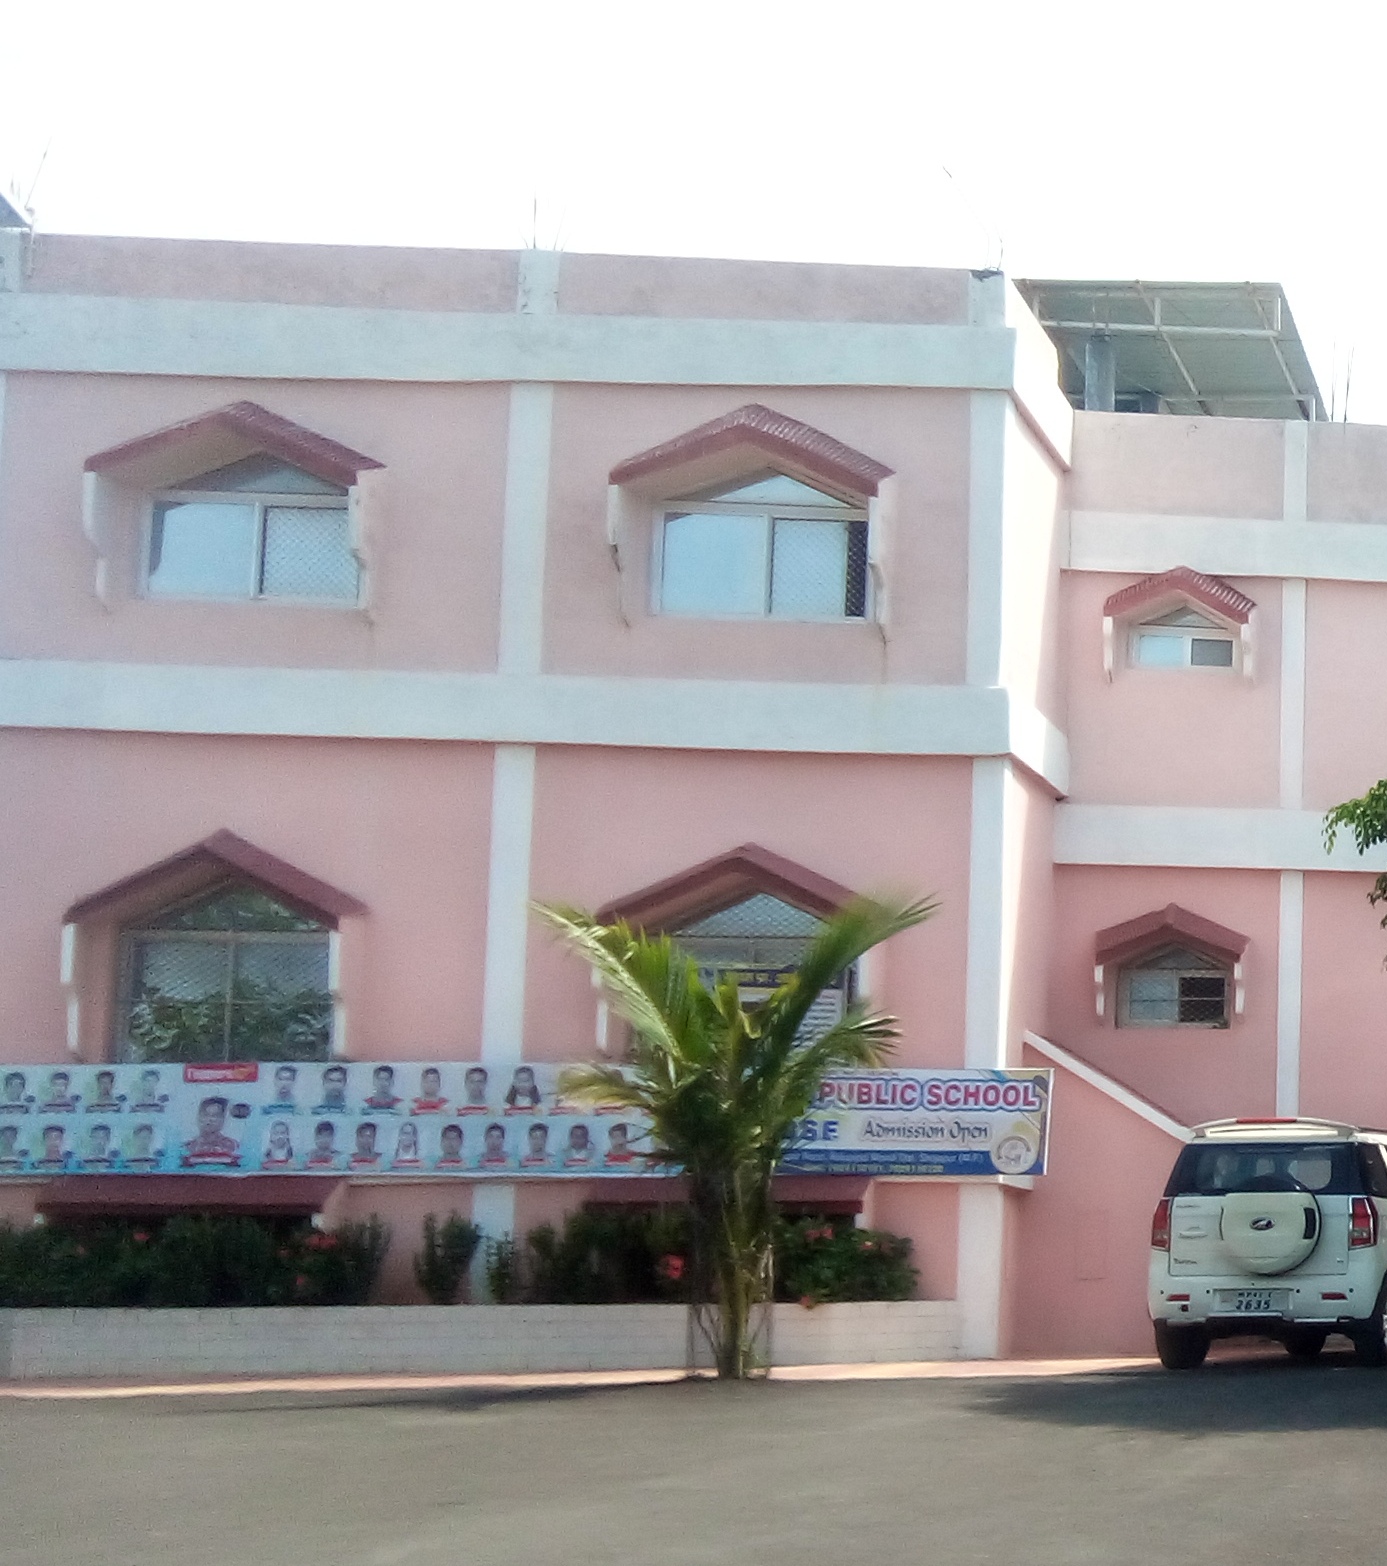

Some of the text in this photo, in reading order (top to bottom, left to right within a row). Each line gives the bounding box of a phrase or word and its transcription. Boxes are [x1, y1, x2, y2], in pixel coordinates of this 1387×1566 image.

[820, 1082, 1037, 1106] PUBLIC SCHOOL
[863, 1120, 988, 1141] Admission Open
